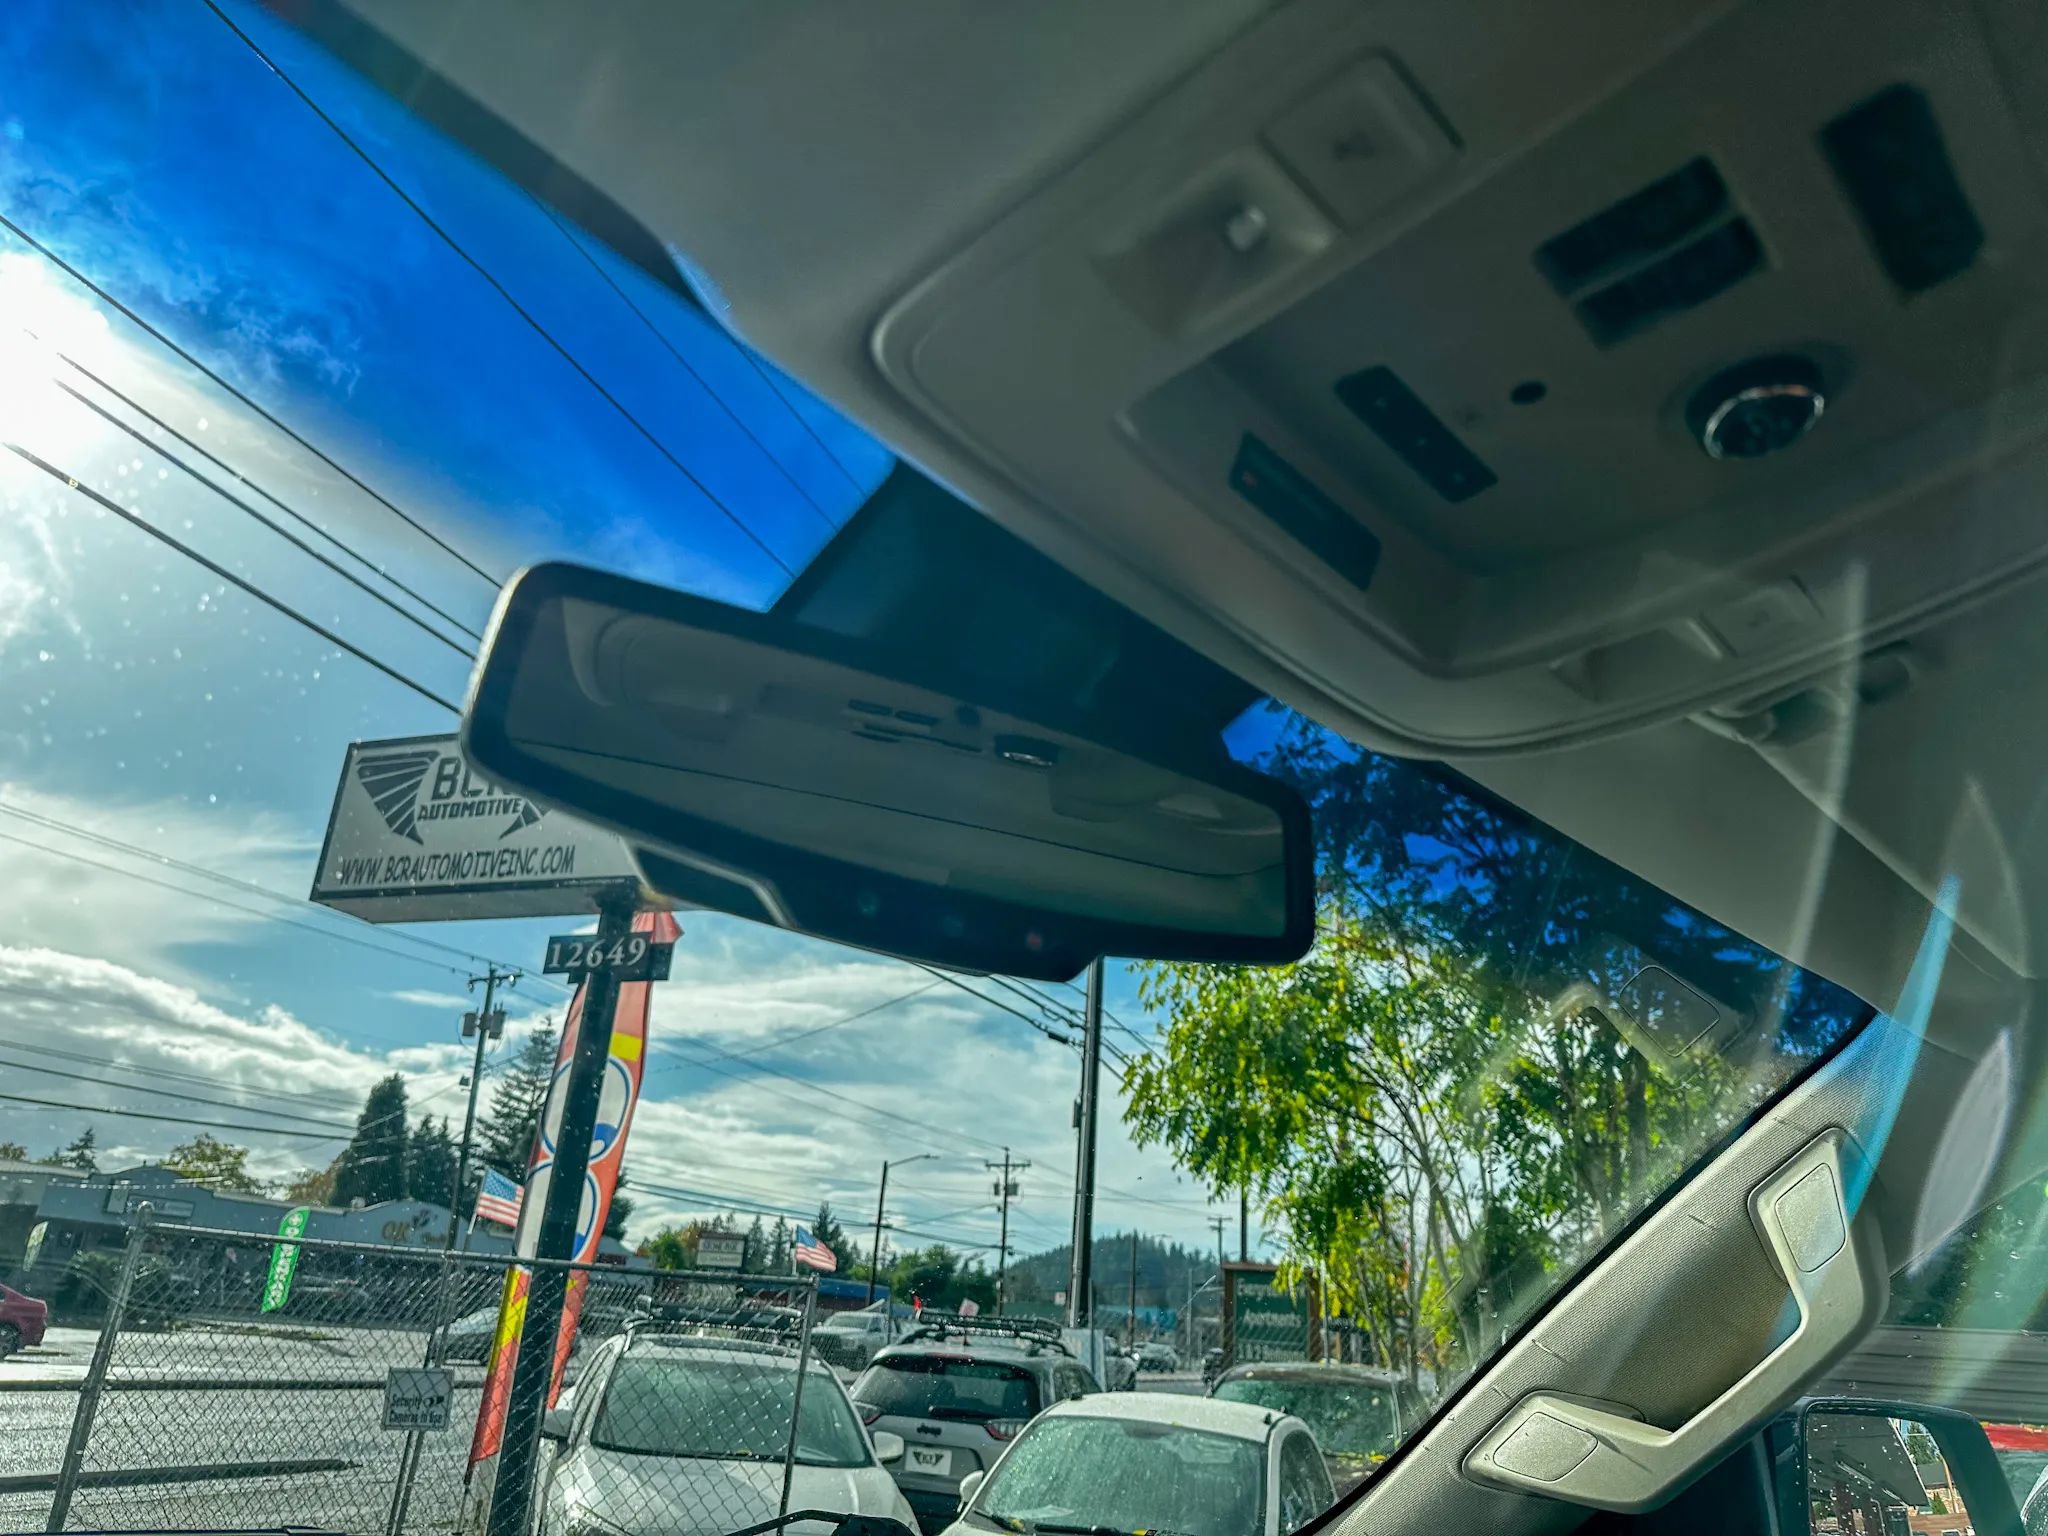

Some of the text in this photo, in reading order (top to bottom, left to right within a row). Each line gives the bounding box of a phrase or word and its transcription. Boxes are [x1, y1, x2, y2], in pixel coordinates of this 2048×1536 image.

[431, 757, 513, 800] BC
[417, 798, 522, 820] AUTOMOTIVE
[339, 845, 575, 885] WWW.BCRAUTOMOTIVEINC.COM
[548, 937, 646, 969] 12649
